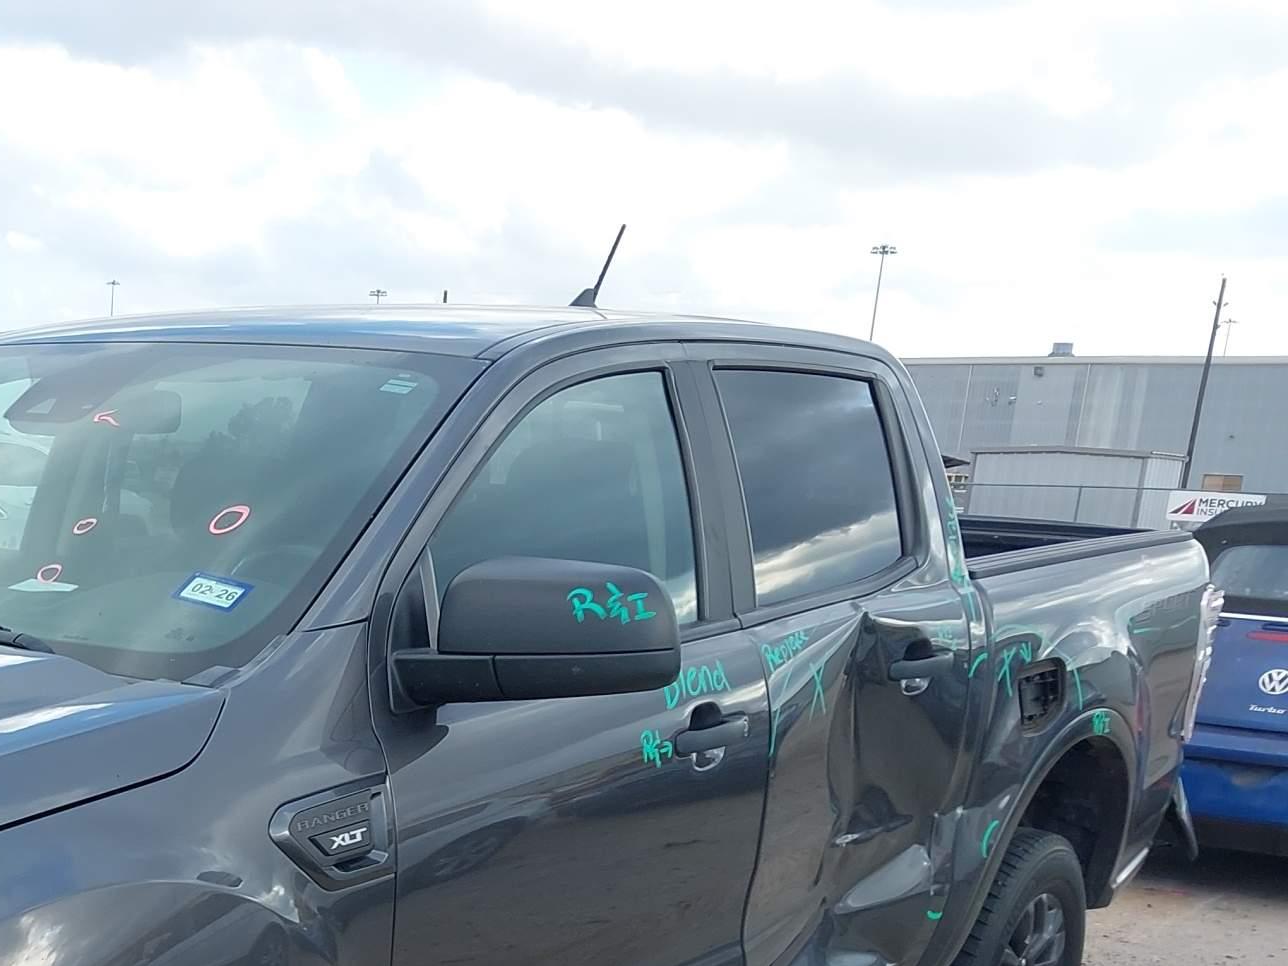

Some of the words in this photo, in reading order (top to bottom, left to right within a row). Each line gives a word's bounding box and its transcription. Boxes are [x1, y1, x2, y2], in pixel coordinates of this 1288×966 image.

[191, 583, 212, 595] 02
[215, 589, 238, 601] 26
[296, 802, 369, 832] RANGER
[329, 827, 368, 850] XLT
